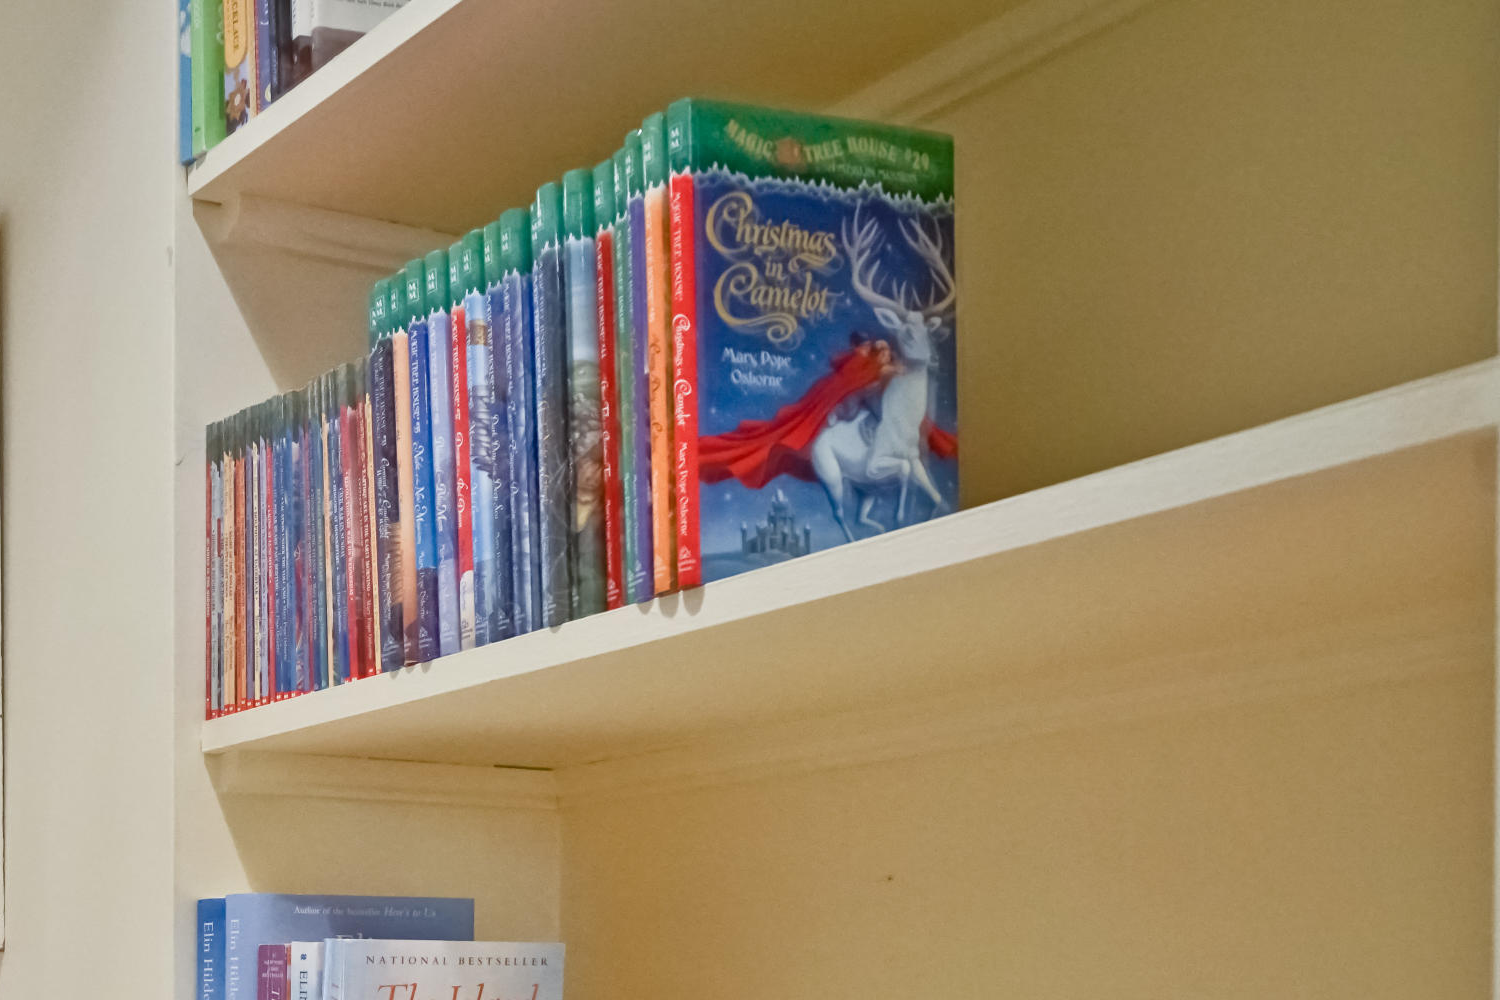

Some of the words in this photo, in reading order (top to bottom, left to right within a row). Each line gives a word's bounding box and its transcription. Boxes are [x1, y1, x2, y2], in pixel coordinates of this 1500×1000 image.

[724, 119, 774, 159] MAGIC
[802, 139, 845, 163] TREE
[846, 137, 897, 163] HOUSE
[705, 191, 837, 273] Christmas
[766, 256, 786, 280] in
[713, 262, 844, 342] Camelot
[722, 347, 758, 368] Mary
[761, 350, 792, 370] Pope
[411, 359, 419, 385] TREE
[731, 368, 784, 386] Osborne
[293, 905, 321, 915] Author
[203, 921, 214, 952] Elin
[229, 919, 240, 951] Elin
[365, 955, 449, 966] NATIONAL
[458, 956, 549, 967] BESTSELLER
